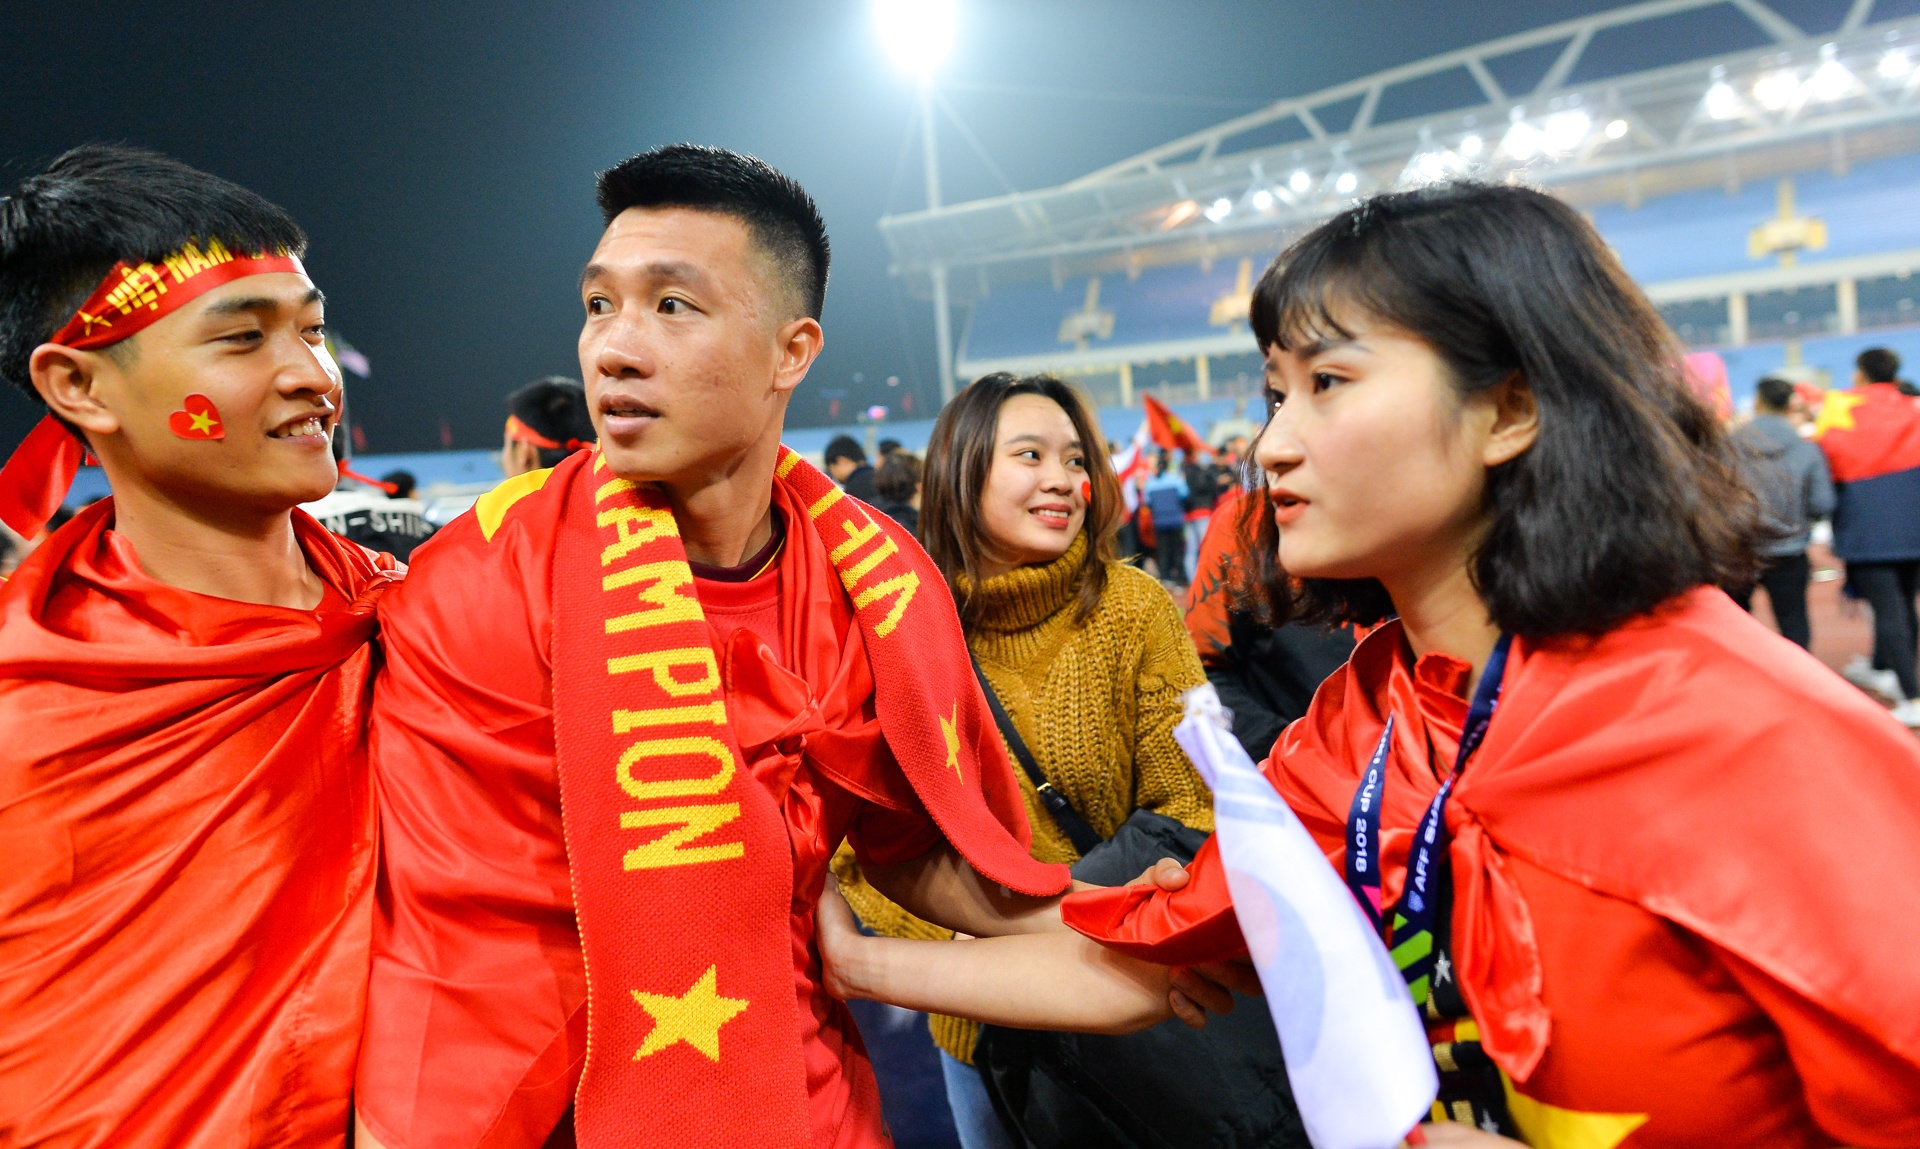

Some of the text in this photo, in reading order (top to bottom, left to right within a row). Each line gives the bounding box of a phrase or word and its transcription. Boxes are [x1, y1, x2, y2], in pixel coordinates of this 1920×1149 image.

[163, 236, 234, 284] NAM
[594, 438, 745, 871] AMPION
[1360, 768, 1378, 813] CUP
[1355, 817, 1368, 873] 2018
[1414, 846, 1430, 893] AFF
